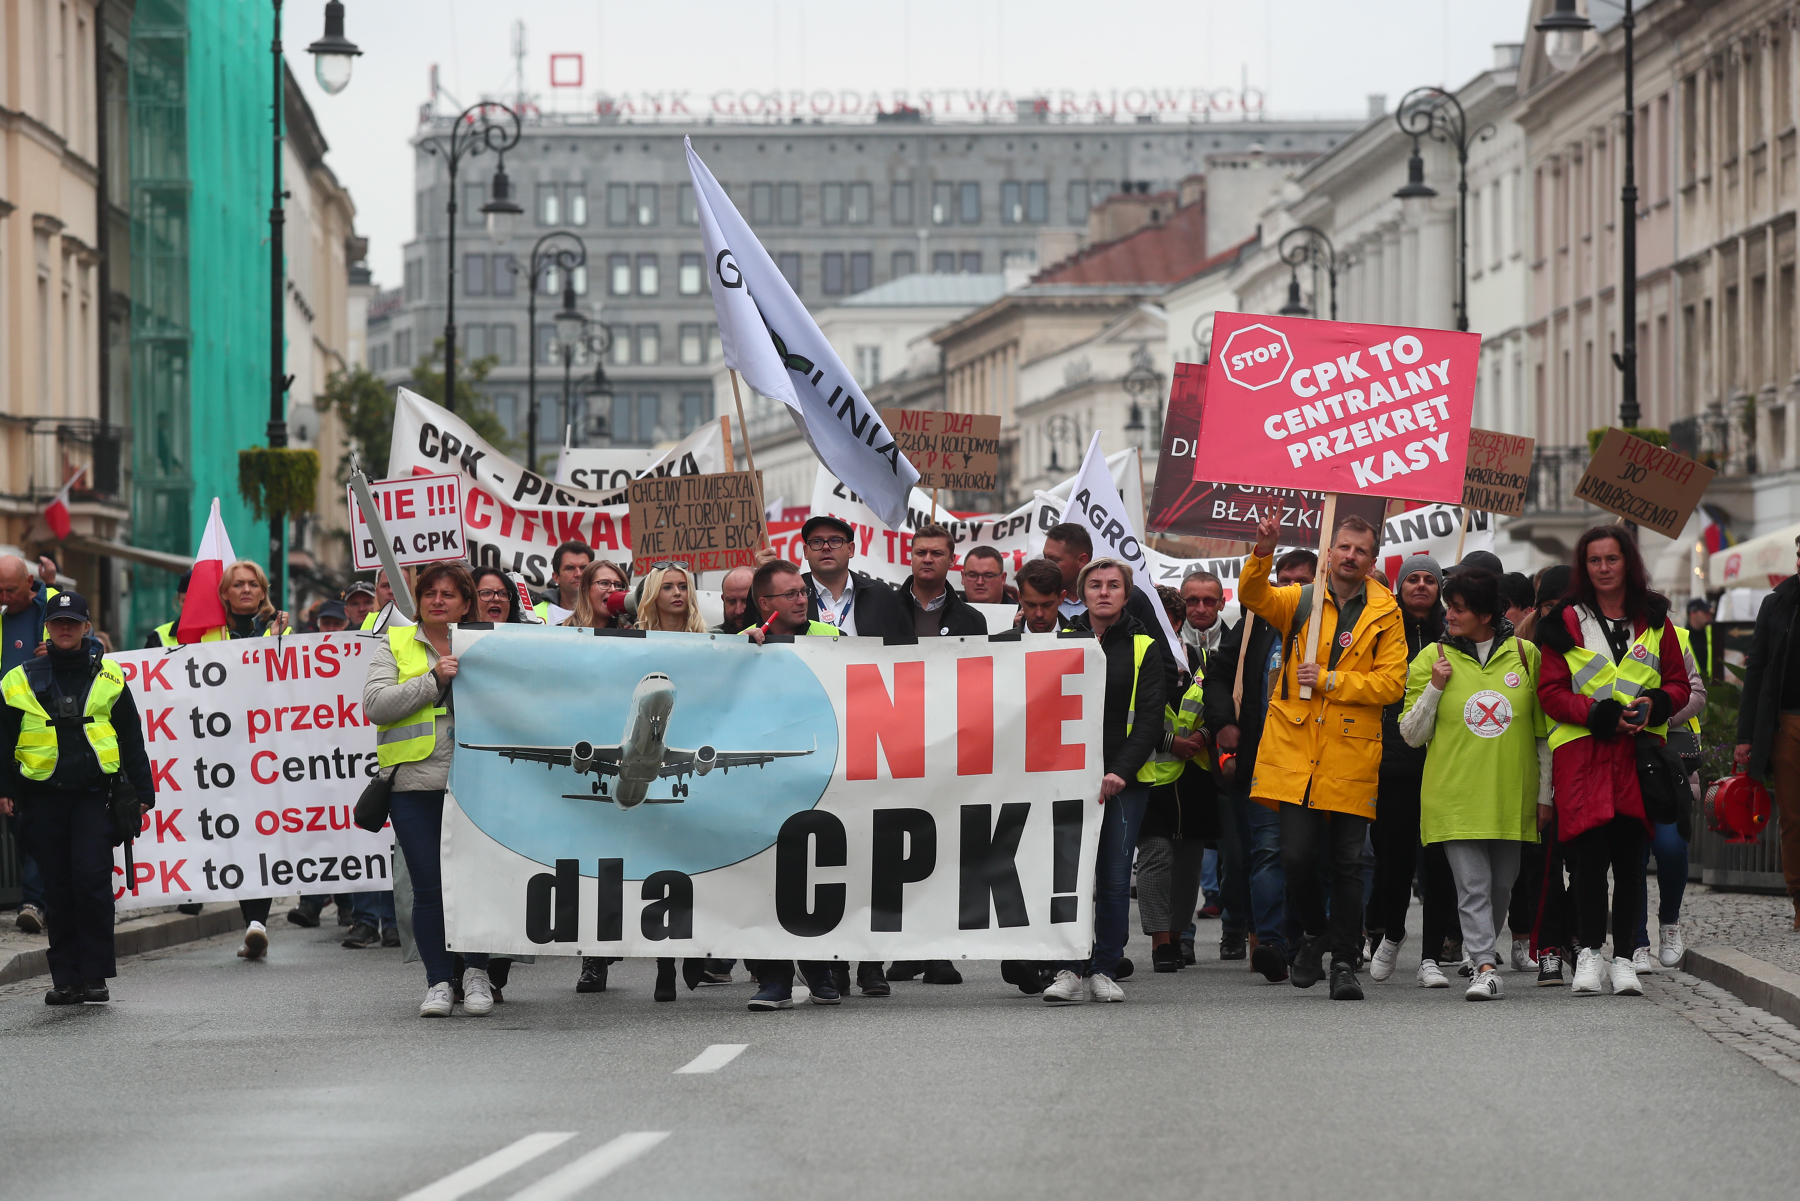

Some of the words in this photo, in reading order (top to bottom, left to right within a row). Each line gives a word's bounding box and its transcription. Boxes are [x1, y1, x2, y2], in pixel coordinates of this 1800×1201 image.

[594, 91, 691, 115] BANK
[712, 90, 1017, 115] GOSPODARSTWA
[1034, 88, 1264, 114] KRAJOWEGO
[1231, 342, 1283, 371] STOP
[1291, 351, 1371, 398] CPK
[1368, 335, 1423, 373] TO
[1263, 358, 1451, 440] CENTRALNY
[899, 410, 934, 431] NIE
[941, 412, 973, 434] DLA
[1286, 394, 1451, 469] PRZEKRĘT
[419, 423, 486, 481] CPK
[1350, 431, 1451, 489] KASY
[1473, 449, 1508, 472] CPK
[1619, 436, 1695, 485] HORAŁA
[1617, 462, 1647, 483] DO
[427, 484, 456, 517] !!!
[632, 480, 682, 503] CHCEMY
[684, 478, 701, 500] TU
[643, 508, 648, 530] I
[1380, 504, 1488, 547] ANÓW
[363, 535, 407, 559] DA
[413, 530, 458, 553] CPK
[639, 532, 666, 555] NIE
[673, 526, 718, 551] MOŻE
[700, 551, 722, 571] BEZ
[185, 656, 227, 689] to
[190, 706, 232, 739] to
[846, 648, 1086, 781] NIE
[194, 757, 235, 790] to
[251, 747, 379, 785] Centra
[198, 808, 240, 840] to
[203, 858, 244, 890] to
[526, 858, 694, 945] dla
[775, 799, 1085, 938] CPK!
